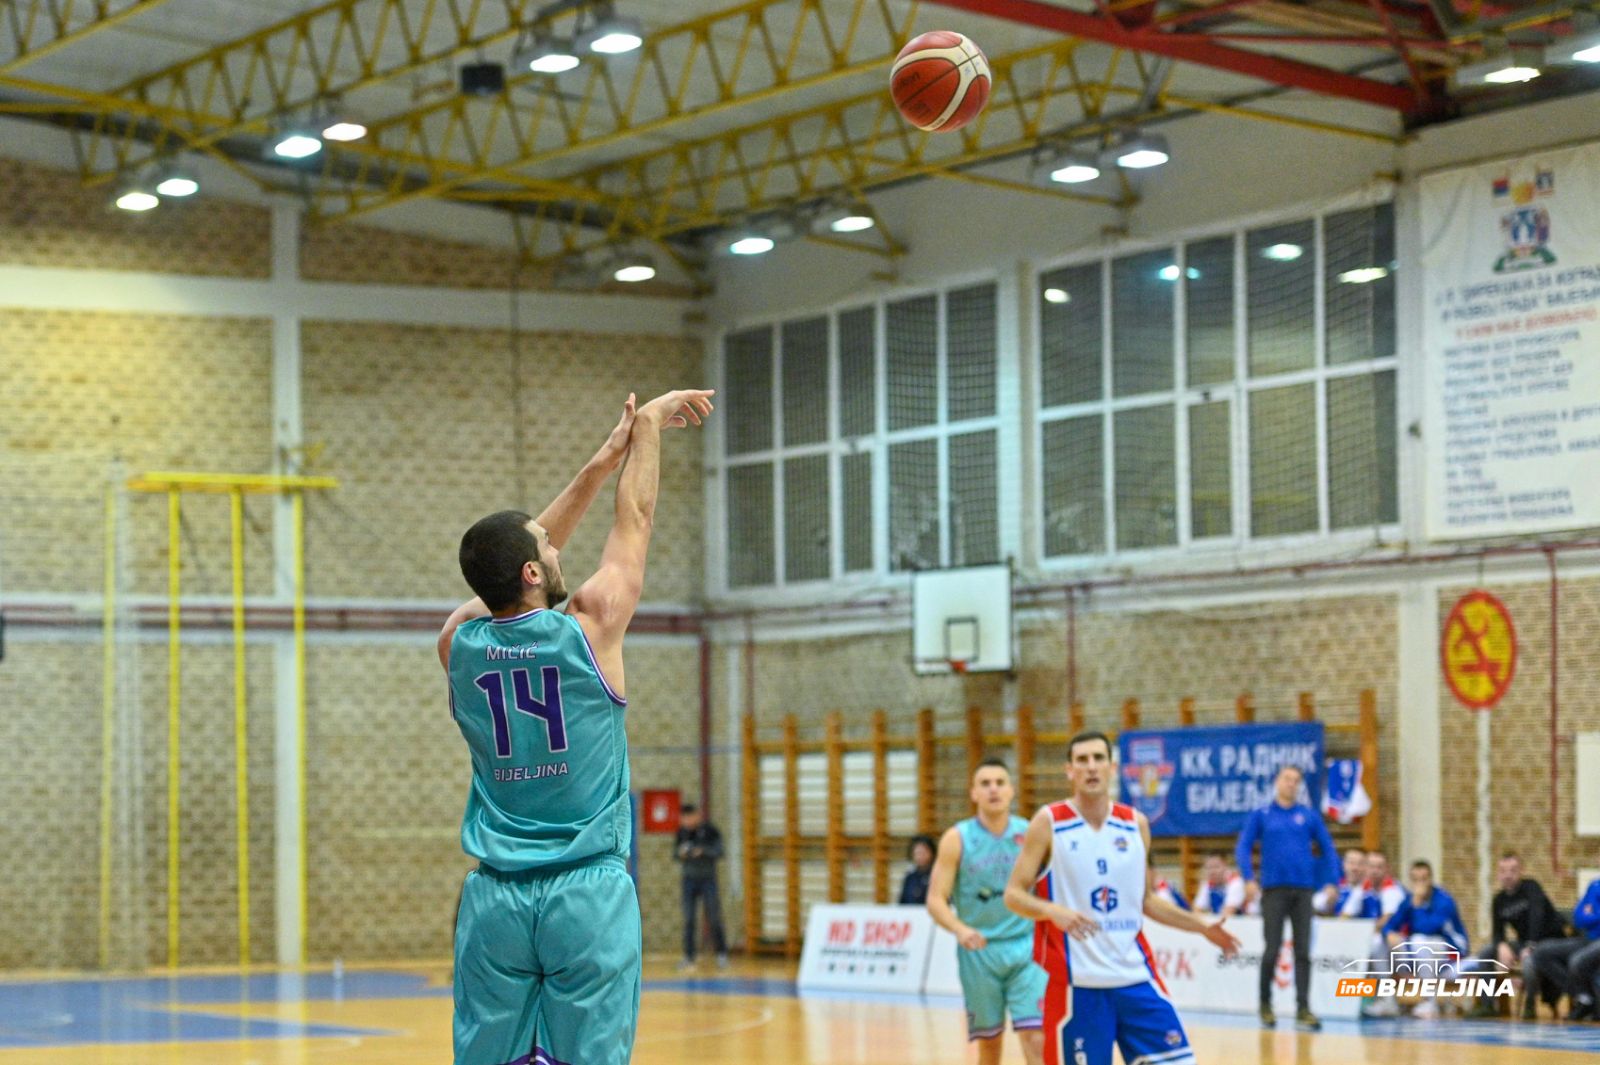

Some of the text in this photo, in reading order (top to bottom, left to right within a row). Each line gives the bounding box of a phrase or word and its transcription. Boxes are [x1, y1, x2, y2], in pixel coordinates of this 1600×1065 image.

[486, 641, 538, 661] MIČIĆ
[473, 665, 568, 759] 14
[493, 762, 569, 782] BIJELJINA
[1096, 858, 1108, 876] 9
